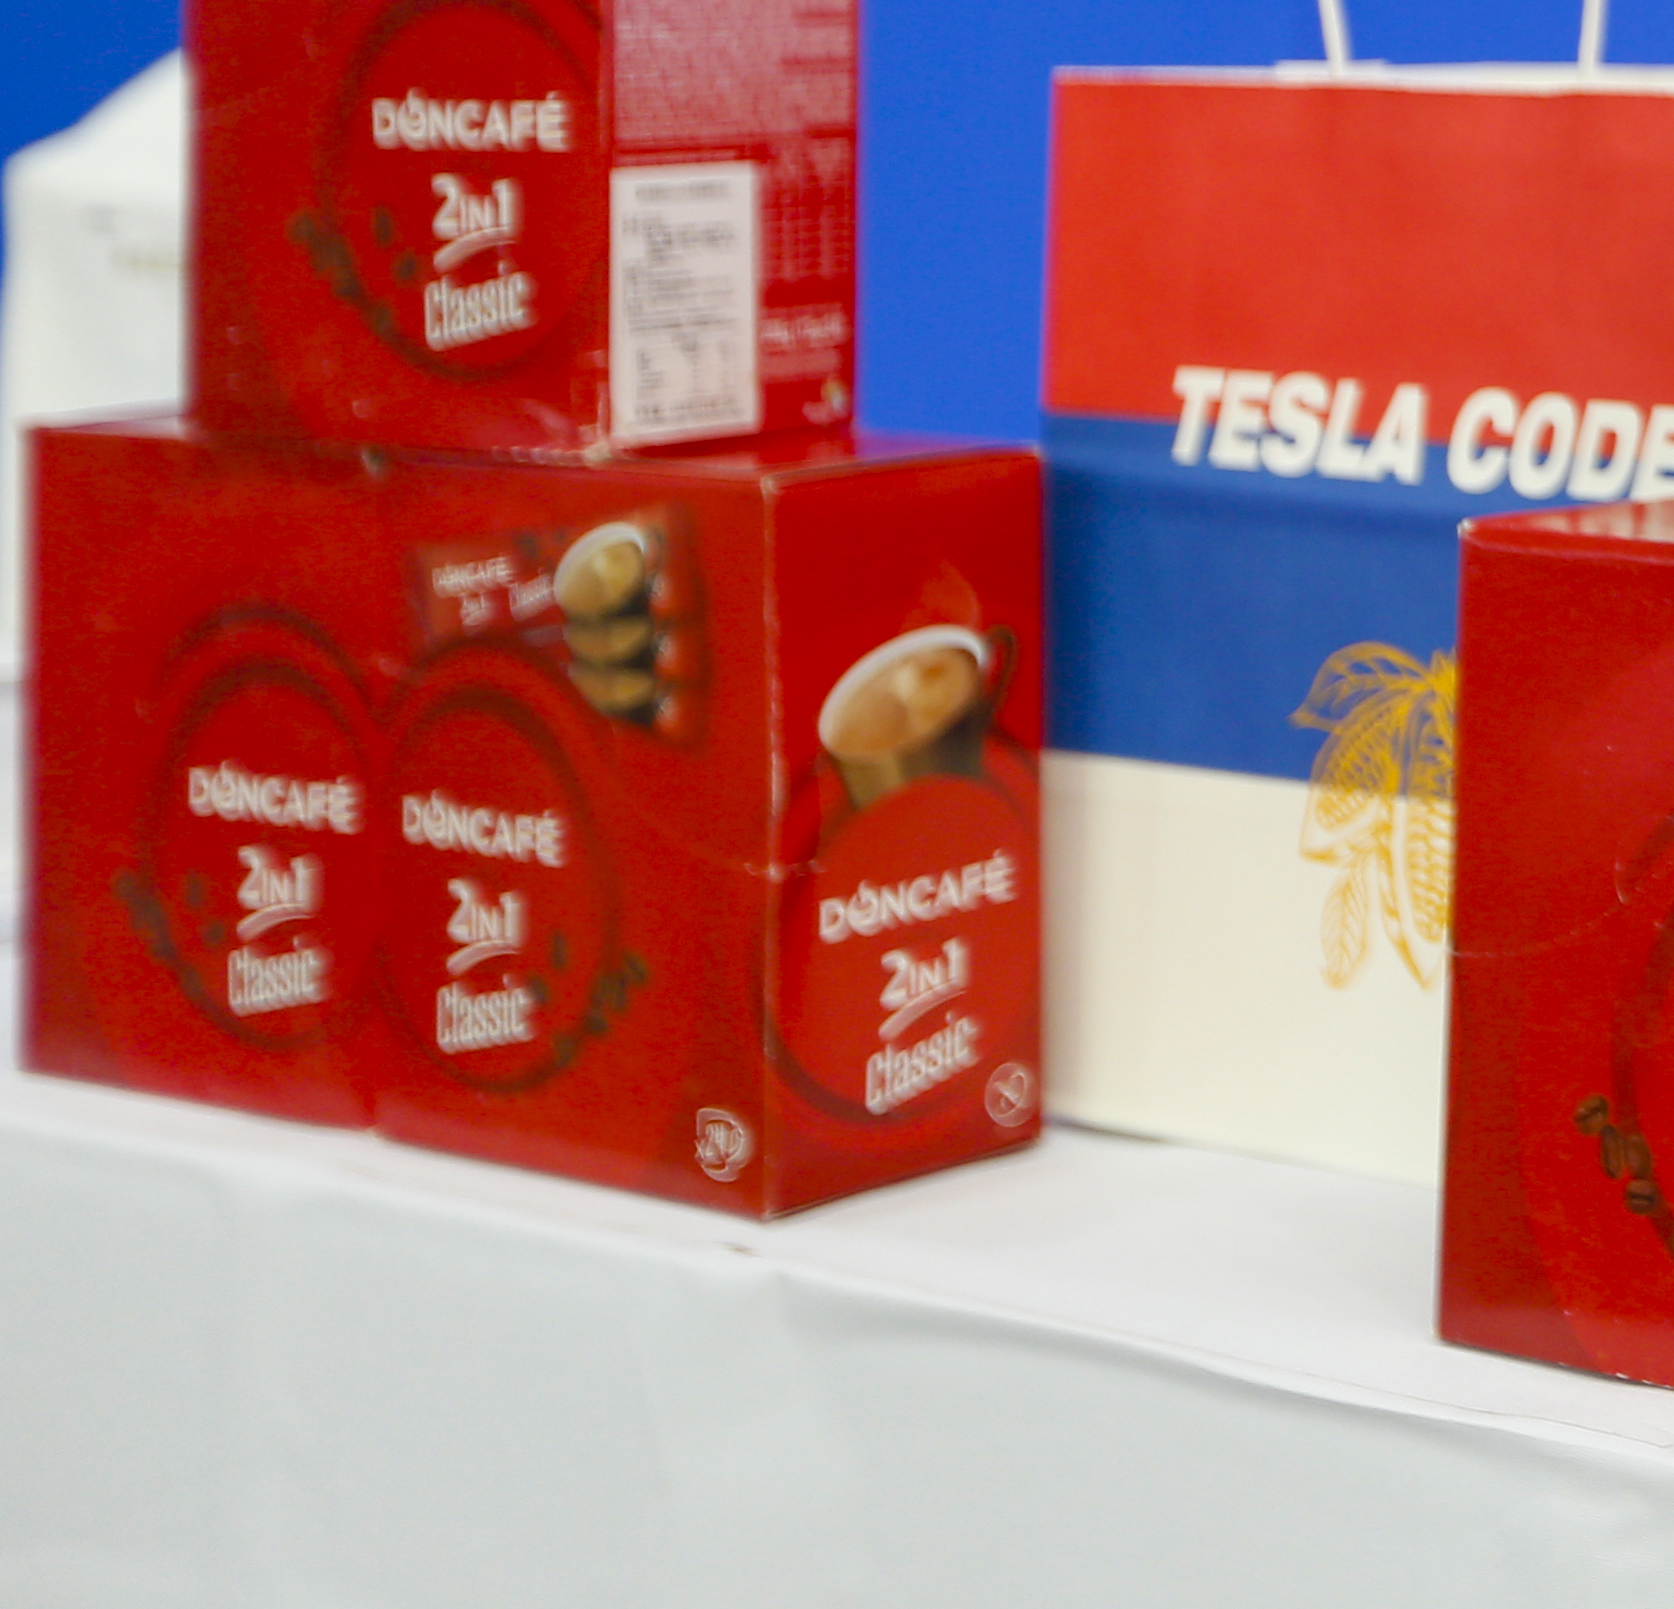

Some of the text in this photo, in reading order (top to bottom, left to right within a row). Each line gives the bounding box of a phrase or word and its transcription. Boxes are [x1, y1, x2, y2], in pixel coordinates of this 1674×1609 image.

[371, 89, 569, 151] DONCAFÉ
[424, 263, 532, 350] Classic
[1173, 367, 1427, 483] TESLA
[188, 761, 358, 833] DONCAFÉ
[402, 791, 564, 867] DONCAFÉ
[820, 851, 1015, 943] DONCAFÉ
[228, 933, 326, 1014] Classic
[437, 971, 534, 1054] Classic
[866, 1011, 980, 1113] Classic
